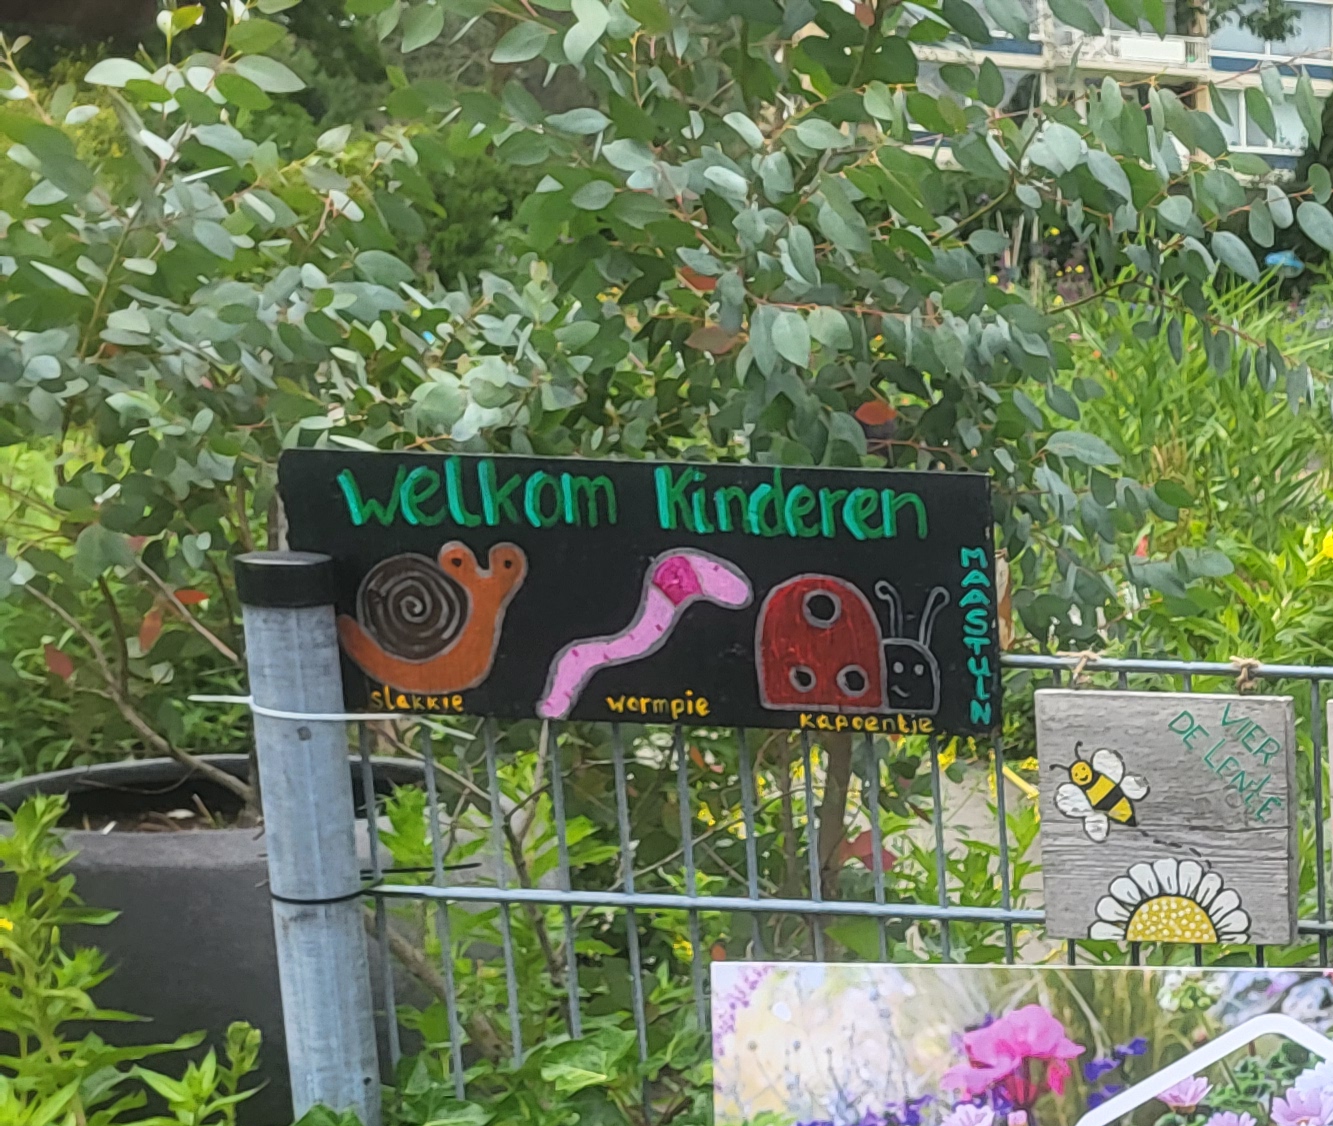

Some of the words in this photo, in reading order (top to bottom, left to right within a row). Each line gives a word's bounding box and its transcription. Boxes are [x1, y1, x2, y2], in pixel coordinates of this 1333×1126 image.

[654, 465, 928, 541] Kinderen
[605, 689, 710, 719] wormpie
[1221, 702, 1281, 766] VIER
[1167, 710, 1210, 751] DE
[1203, 738, 1283, 823] LENTE
